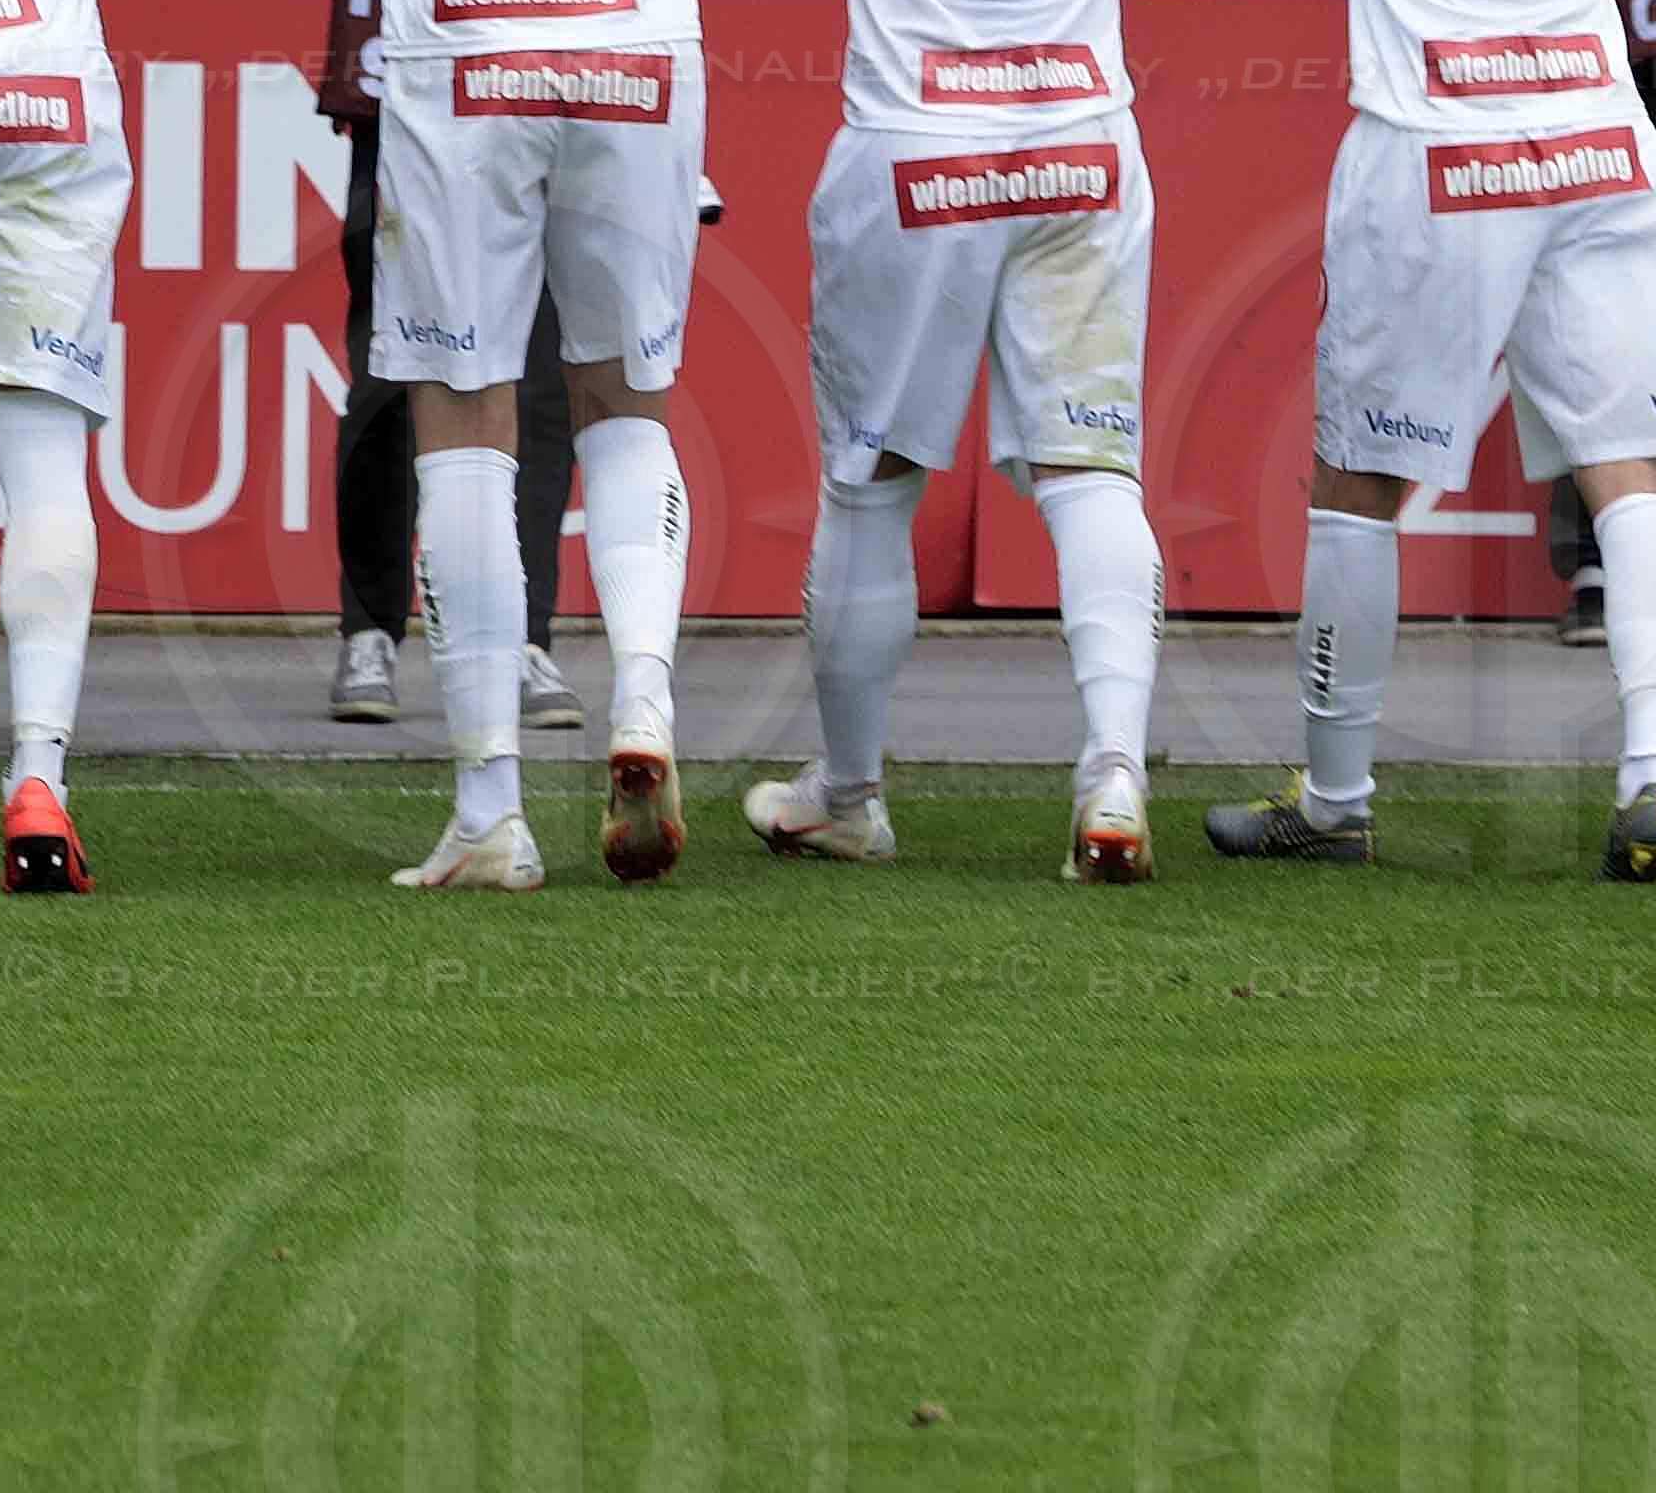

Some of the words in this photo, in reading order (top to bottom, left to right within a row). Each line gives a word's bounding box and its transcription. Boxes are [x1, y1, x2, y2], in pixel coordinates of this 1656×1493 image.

[463, 63, 661, 112] wienholding
[1438, 46, 1603, 86] wienholding
[909, 161, 1108, 213] wienholding
[1442, 146, 1634, 199] wienholding
[1366, 407, 1454, 449] Verbund
